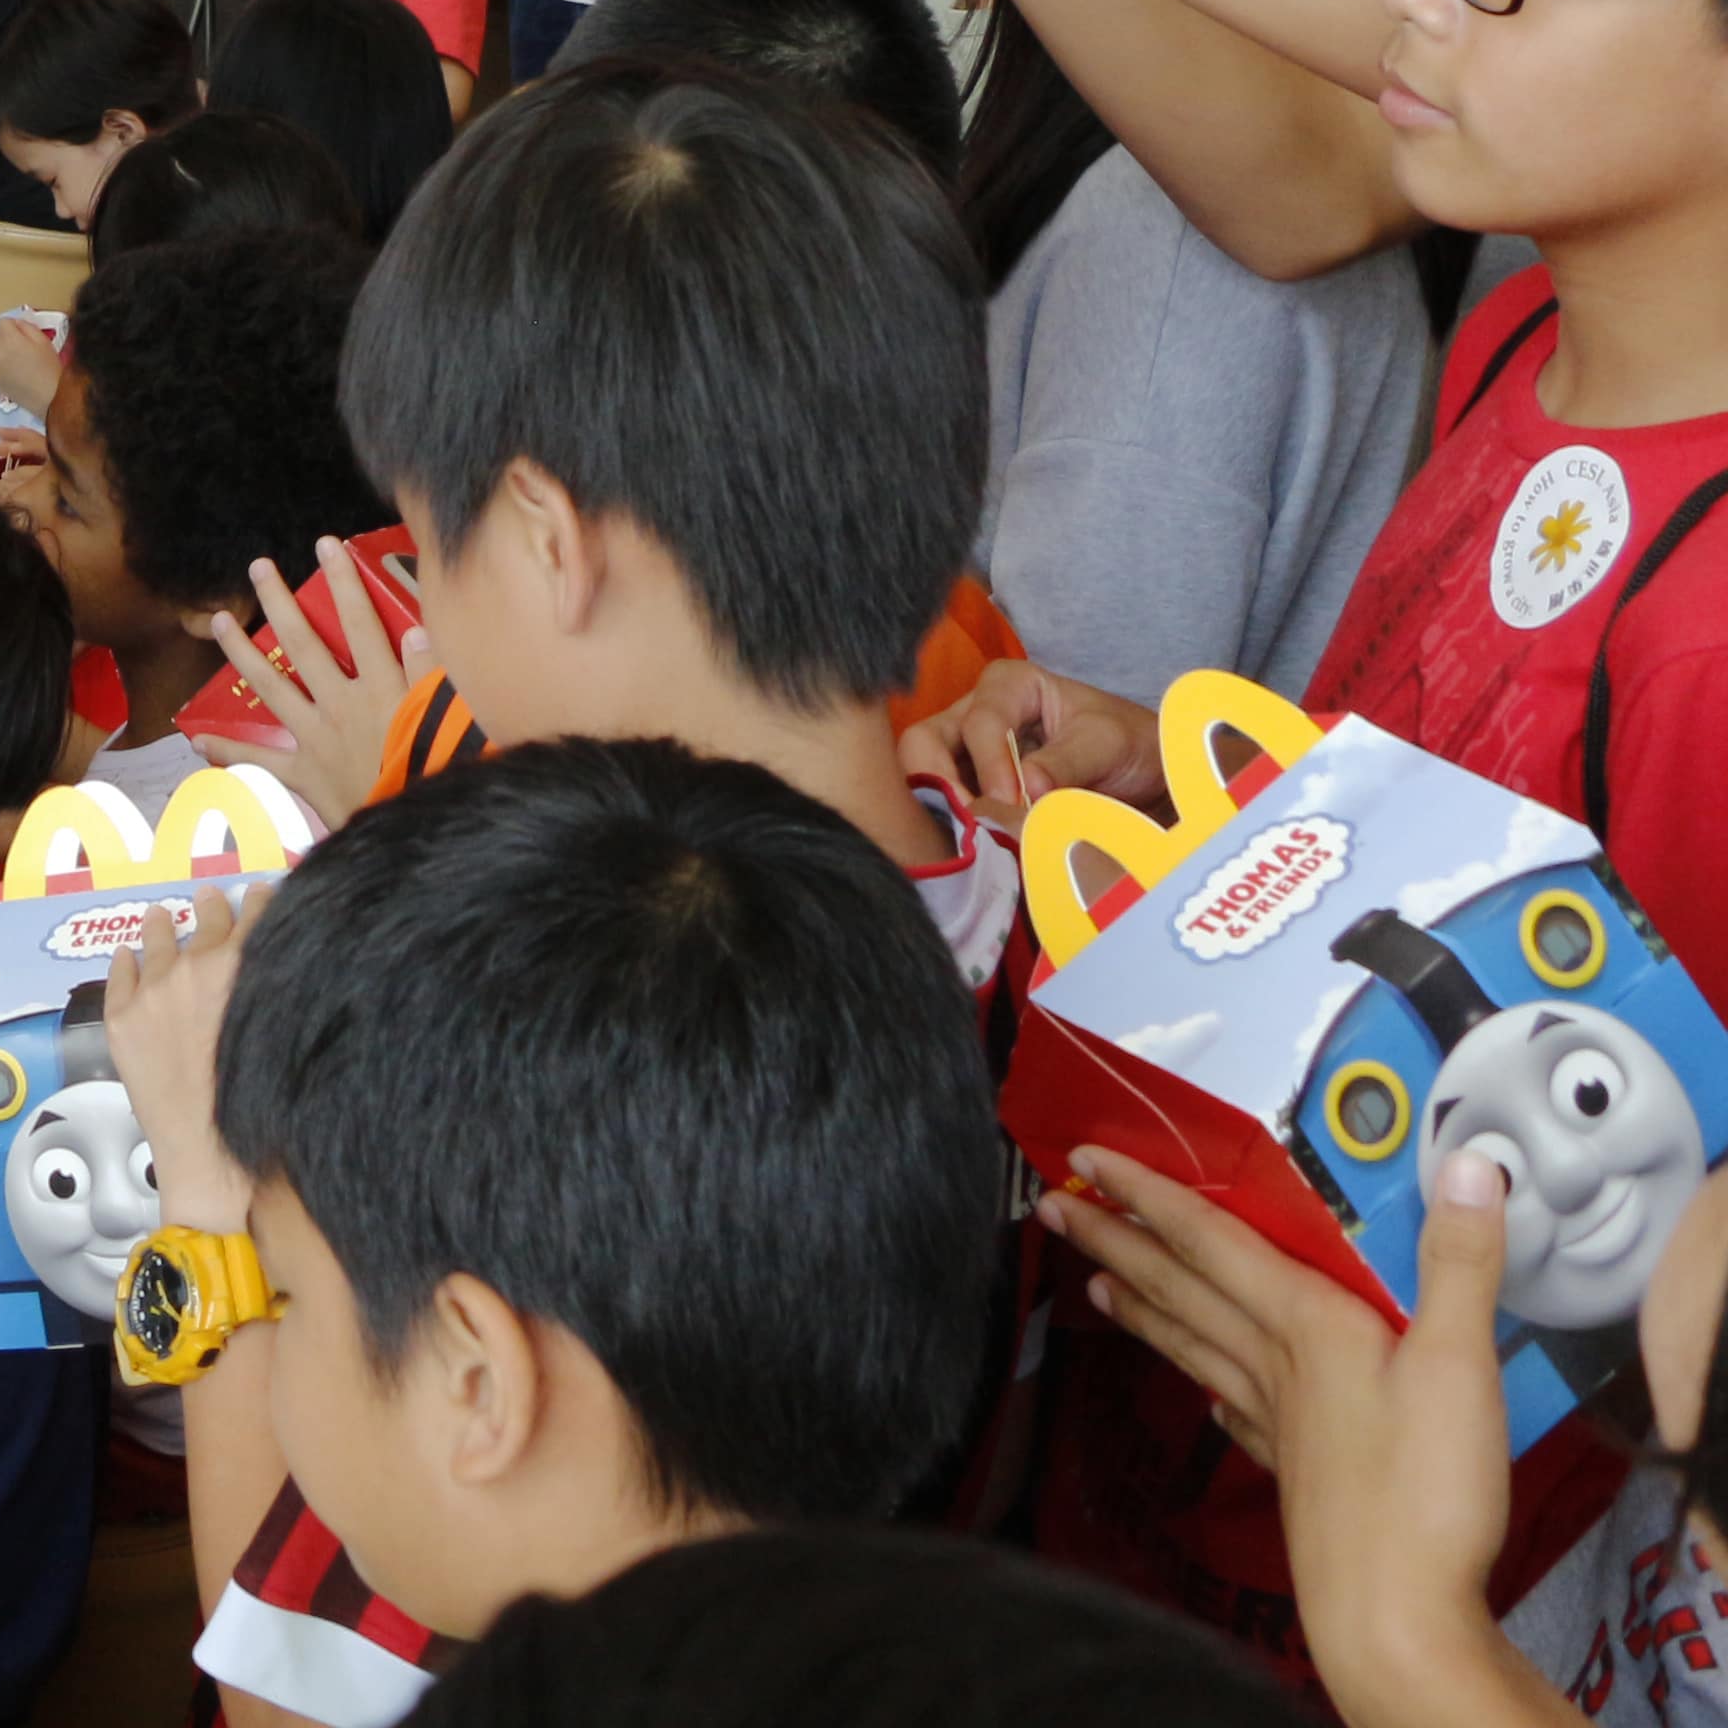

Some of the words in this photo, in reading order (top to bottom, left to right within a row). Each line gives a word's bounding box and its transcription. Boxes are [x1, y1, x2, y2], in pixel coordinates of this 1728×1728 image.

[1523, 470, 1556, 510] How
[1565, 459, 1606, 487] CESL
[1602, 482, 1619, 524] Asia
[1510, 514, 1527, 534] to
[1186, 827, 1319, 925] THOMAS
[1225, 923, 1249, 939] &
[1243, 848, 1333, 923] FRIENDS
[70, 908, 191, 936] THOMS
[71, 936, 86, 947] &
[90, 931, 144, 946] FRIE
